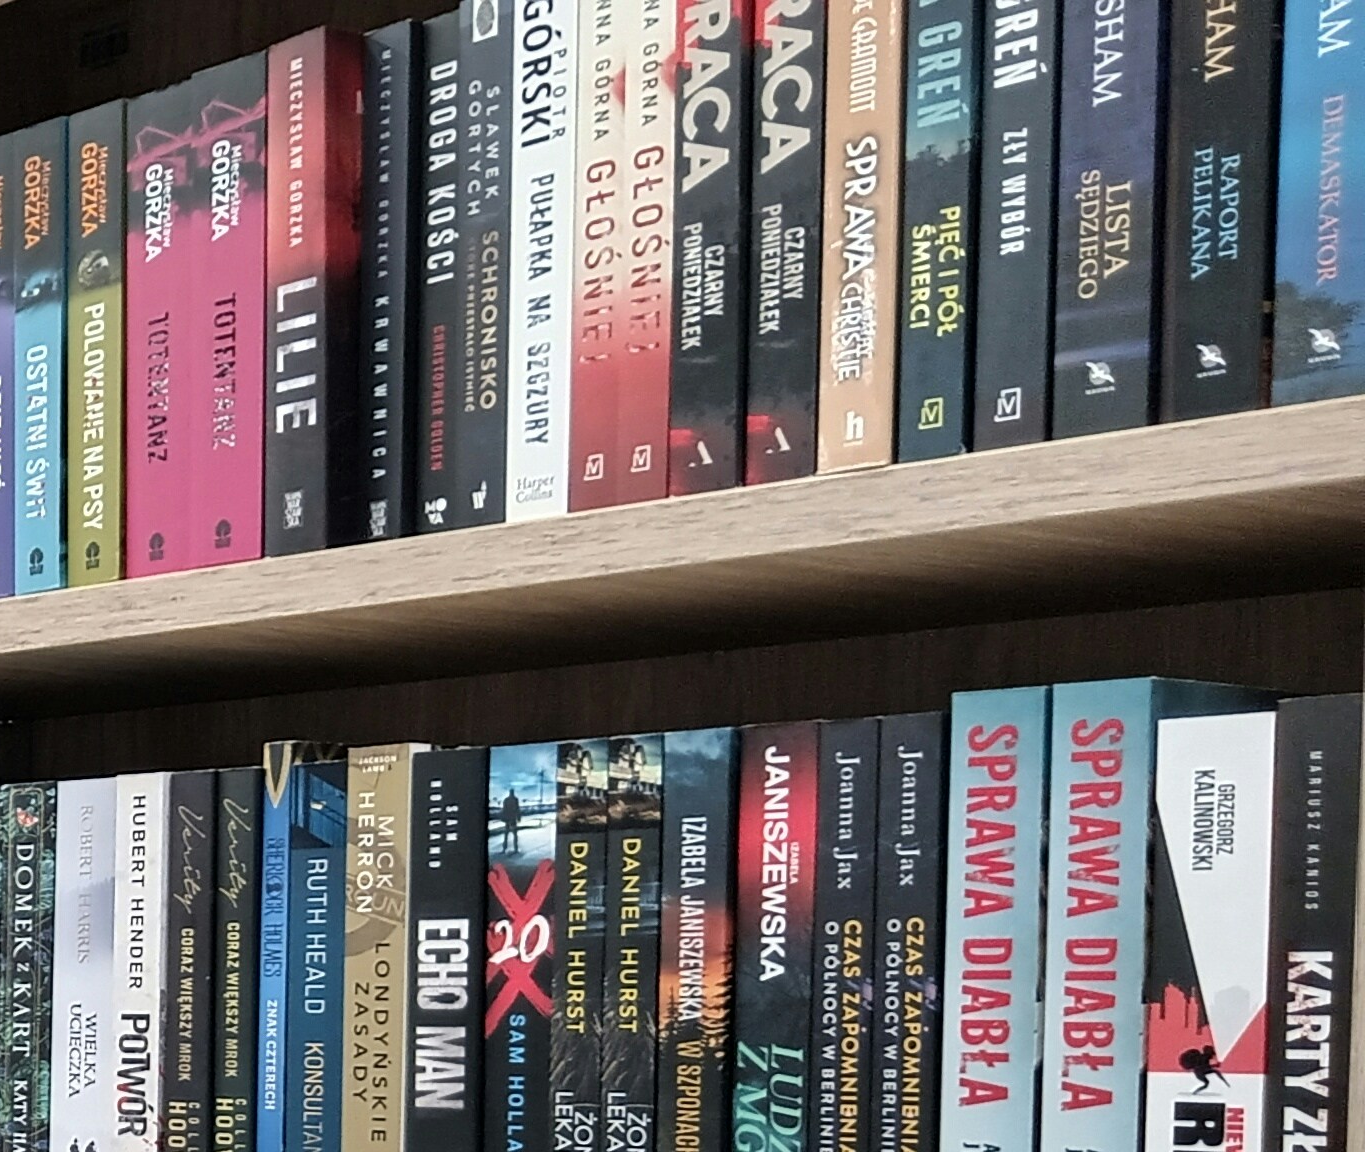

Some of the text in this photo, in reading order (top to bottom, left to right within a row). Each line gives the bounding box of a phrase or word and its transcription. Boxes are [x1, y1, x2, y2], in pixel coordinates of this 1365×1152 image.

[916, 20, 968, 128] GREŃ
[81, 142, 97, 238] GORZKA
[211, 140, 230, 241] GORZKA
[427, 64, 458, 286] DROGA KOŚCI
[999, 129, 1032, 256] ZŁY WYBÓR
[1076, 169, 1099, 300] SĘDZIEGO
[1101, 181, 1131, 279] LISTA
[1316, 95, 1345, 287] DEMASKATOR
[524, 173, 554, 446] PUŁAPKA NA SZCZURY
[758, 203, 782, 337] PONIEDZIAŁEK
[783, 227, 804, 301] CZARNY
[909, 225, 935, 330] ŚMIERCI
[934, 206, 965, 336] PIĘĆ PÓŁ
[25, 344, 47, 450] OSTATNI
[83, 303, 105, 531] POLOWANIE NA PSY
[275, 277, 317, 433] LILIE
[680, 815, 706, 888] IZABELA
[760, 747, 790, 982] JANISZEWSKA
[568, 842, 588, 1033] DANIEL HURST
[677, 895, 703, 1022] JANISZEWSKA
[959, 725, 1019, 1107] SPRAWA DIABŁA
[68, 1004, 81, 1098] UCIECZKA
[82, 1014, 97, 1088] WIELKA
[117, 1013, 149, 1136] POTWÓR
[415, 920, 468, 1109] ECHO MAN
[677, 1041, 700, 1058] W
[737, 1042, 768, 1068] Z
[1286, 951, 1333, 1097] KARTY
